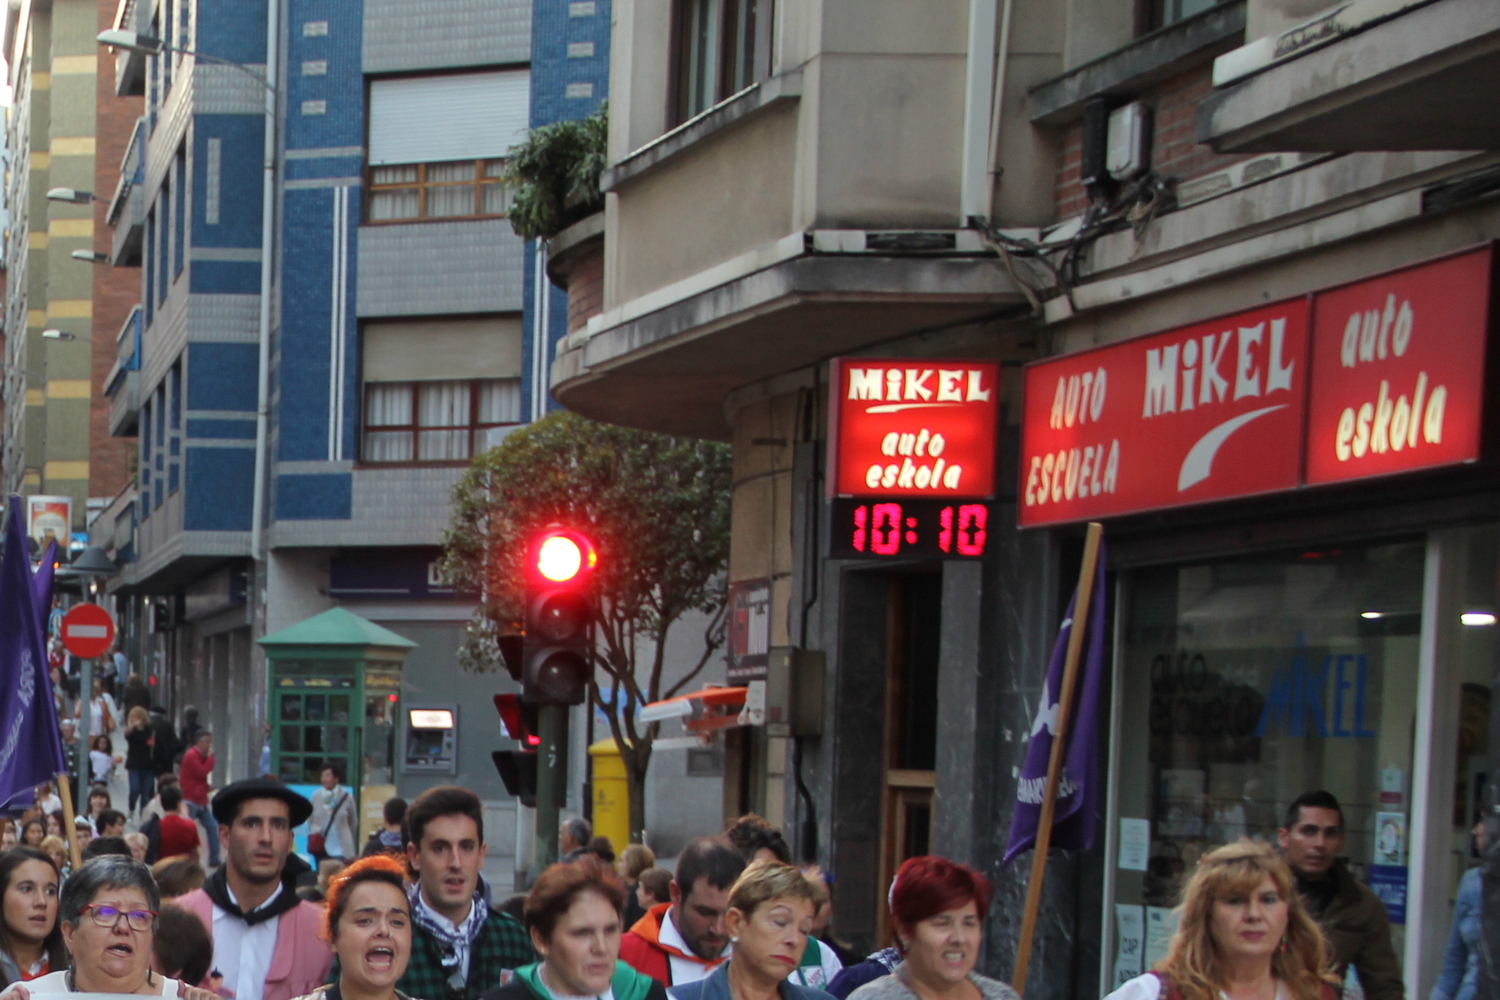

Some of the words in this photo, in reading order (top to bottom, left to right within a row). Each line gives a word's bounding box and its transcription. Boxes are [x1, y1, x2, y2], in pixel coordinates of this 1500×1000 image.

[1341, 293, 1413, 368] auto
[1050, 367, 1107, 430] AUTO
[1336, 371, 1447, 462] eskola
[865, 457, 962, 489] eskola
[881, 428, 945, 457] auto
[1025, 438, 1120, 506] ESCUELA
